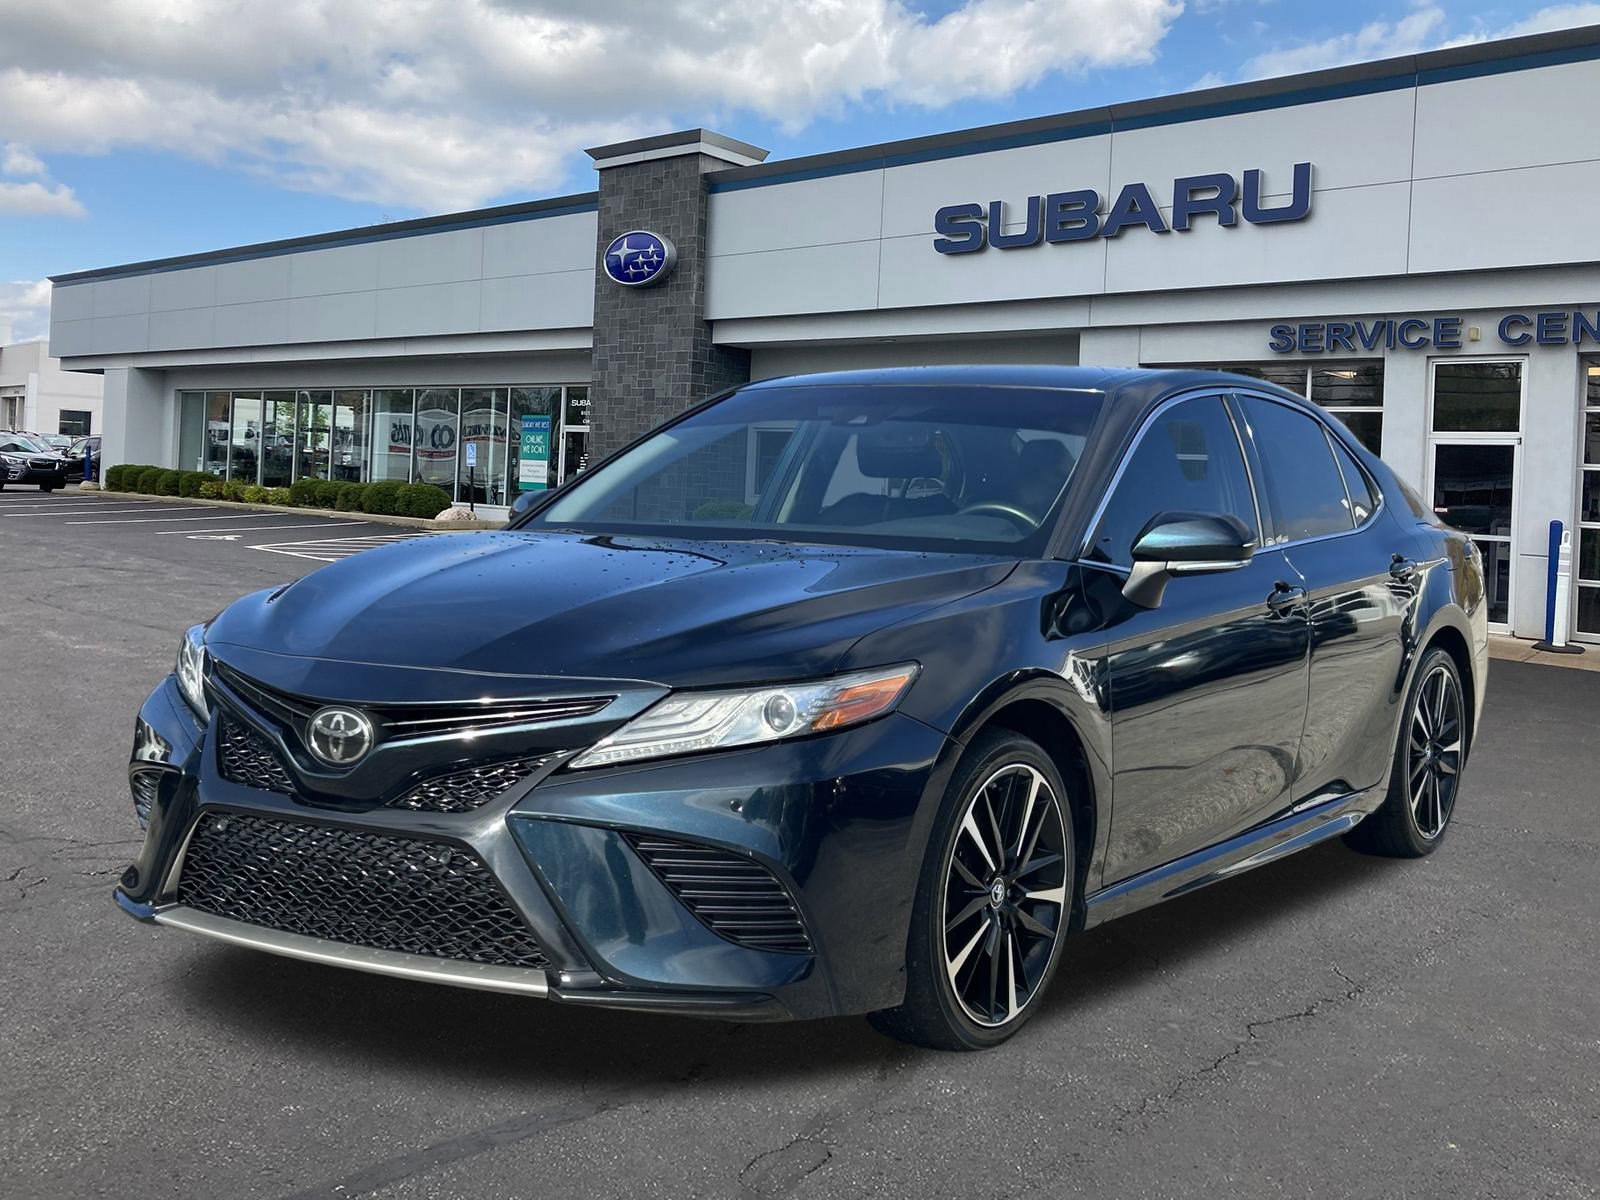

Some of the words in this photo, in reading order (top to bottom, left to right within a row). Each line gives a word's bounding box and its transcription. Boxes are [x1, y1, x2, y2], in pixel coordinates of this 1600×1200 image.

[933, 162, 1314, 255] SUBARU
[1269, 317, 1464, 353] SERVICE
[1497, 311, 1600, 346] CEN
[571, 399, 592, 407] SUBA
